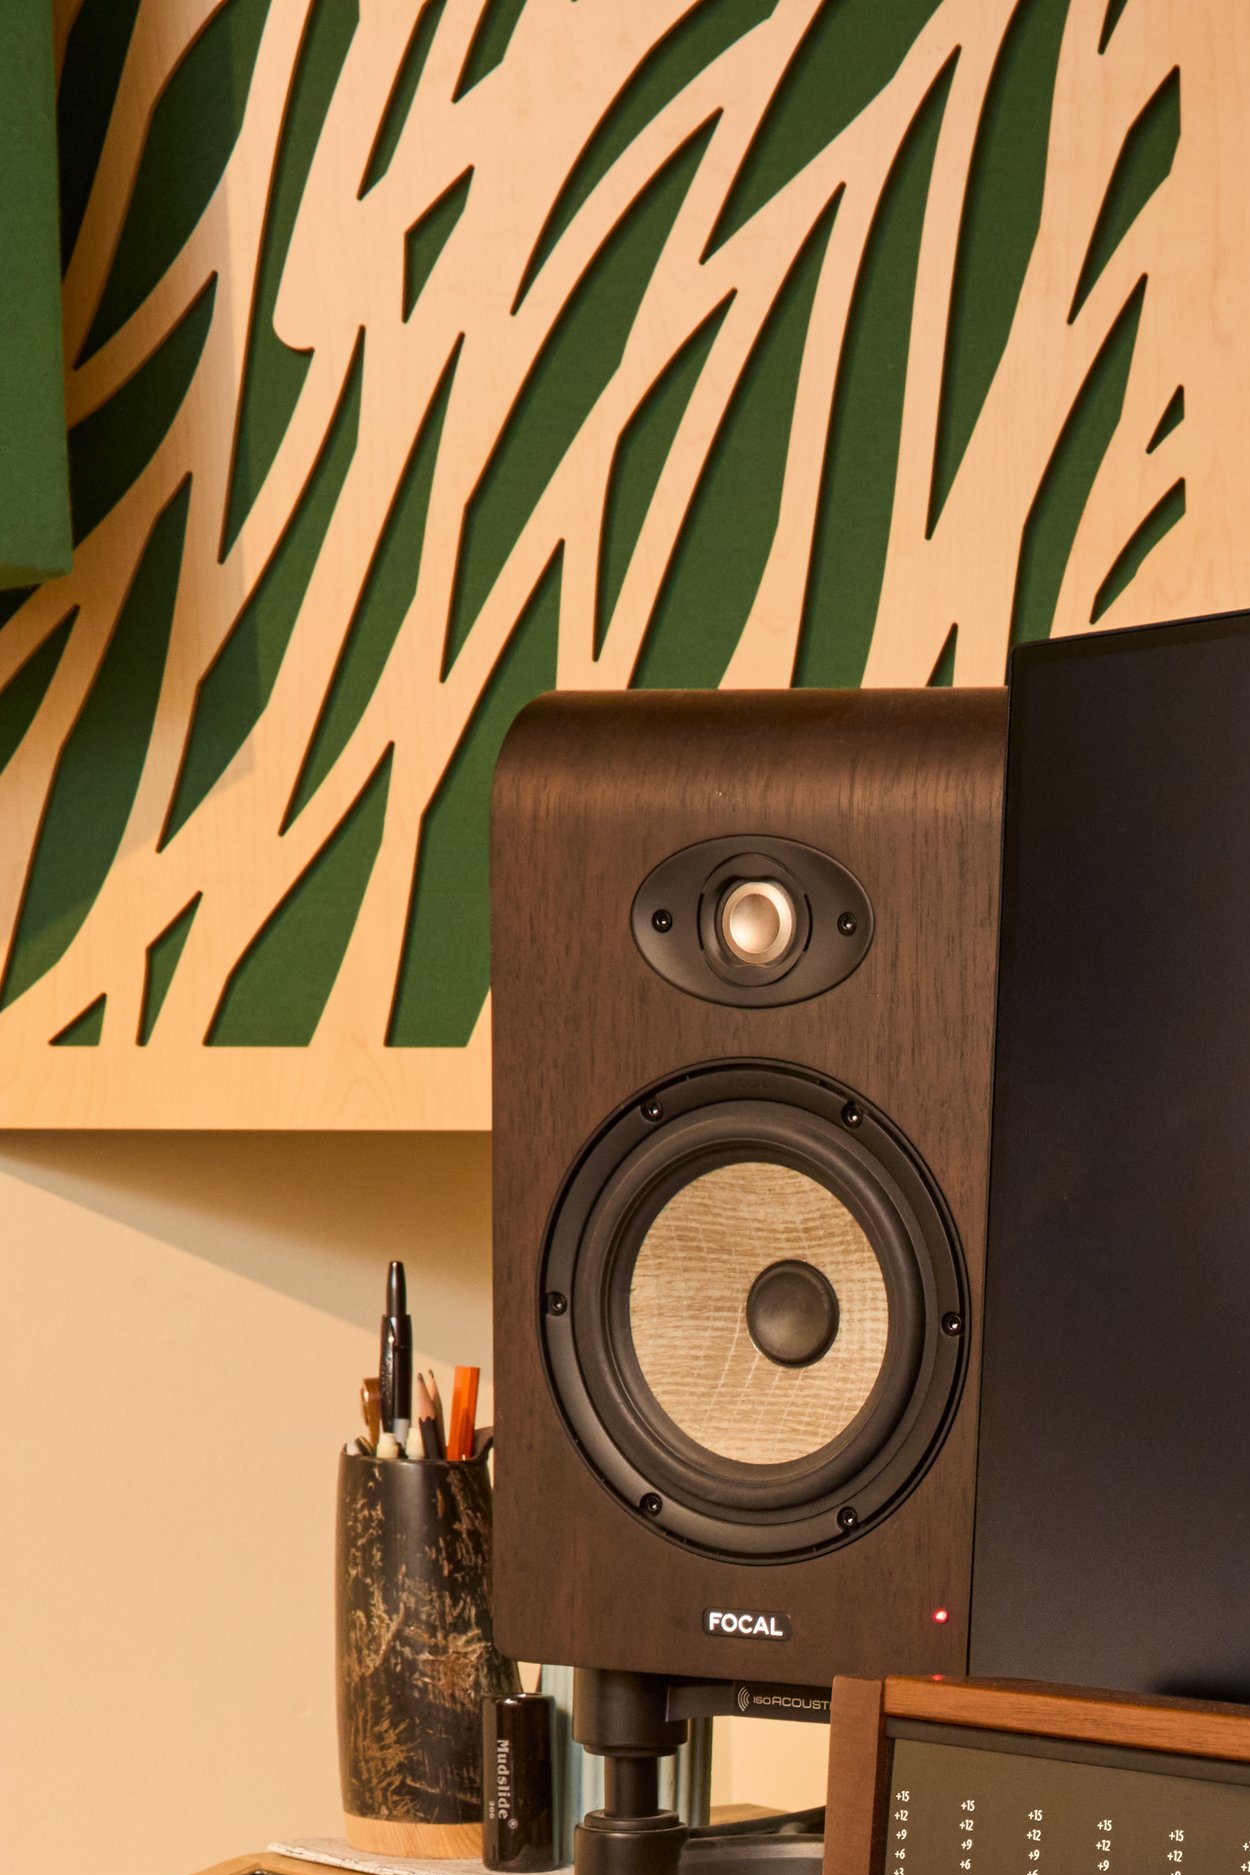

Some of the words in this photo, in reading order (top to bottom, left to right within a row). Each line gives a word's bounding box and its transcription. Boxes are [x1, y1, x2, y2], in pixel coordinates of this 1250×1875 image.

[709, 1612, 783, 1636] FOCAL
[497, 1739, 511, 1820] Mudslide
[1027, 1809, 1043, 1822] +15
[1026, 1828, 1042, 1842] +12
[1028, 1848, 1041, 1861] +9
